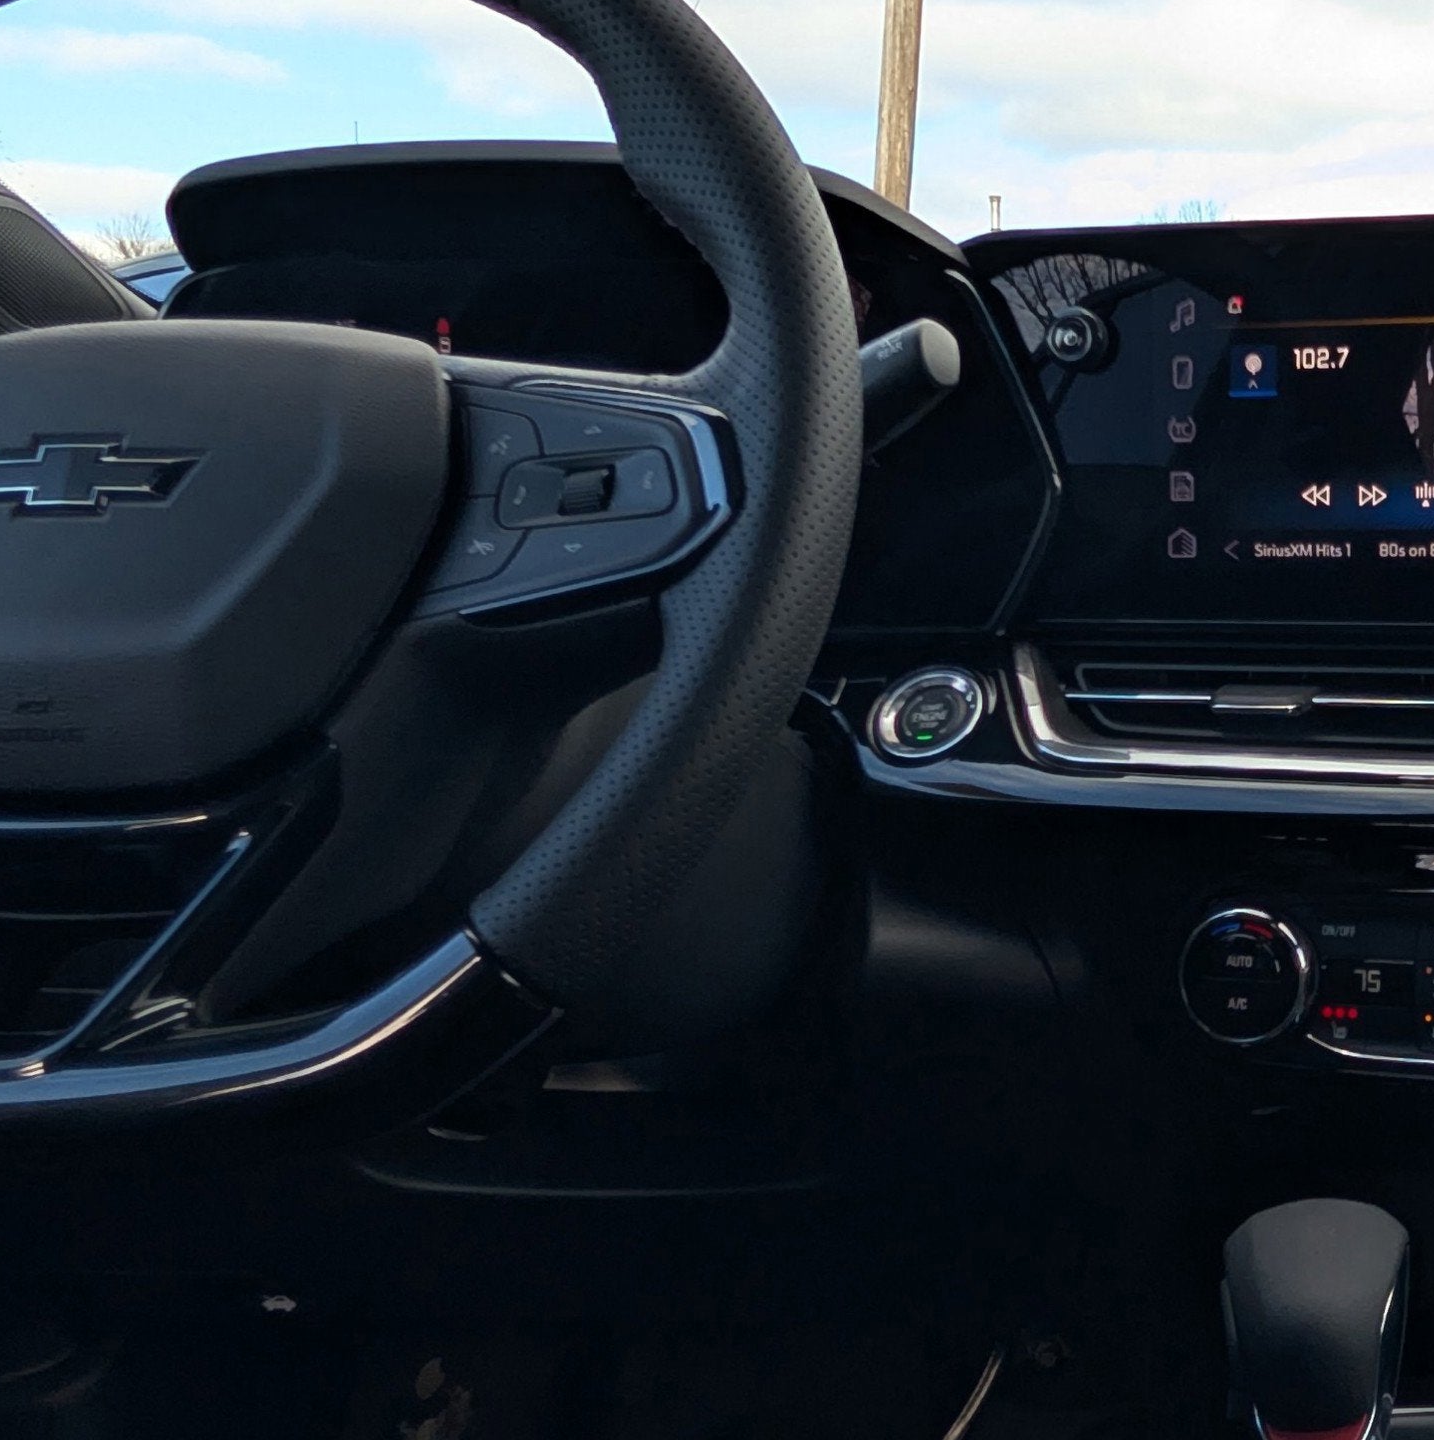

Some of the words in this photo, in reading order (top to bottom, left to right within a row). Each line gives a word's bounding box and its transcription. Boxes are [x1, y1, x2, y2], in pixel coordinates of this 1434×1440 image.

[1293, 346, 1350, 370] 102.7
[1254, 542, 1313, 557] SiriusXM
[1316, 542, 1343, 557] Hits
[1408, 546, 1427, 557] on
[1226, 956, 1253, 968] AUTO
[1354, 969, 1381, 993] 75
[1227, 998, 1248, 1010] A/C
